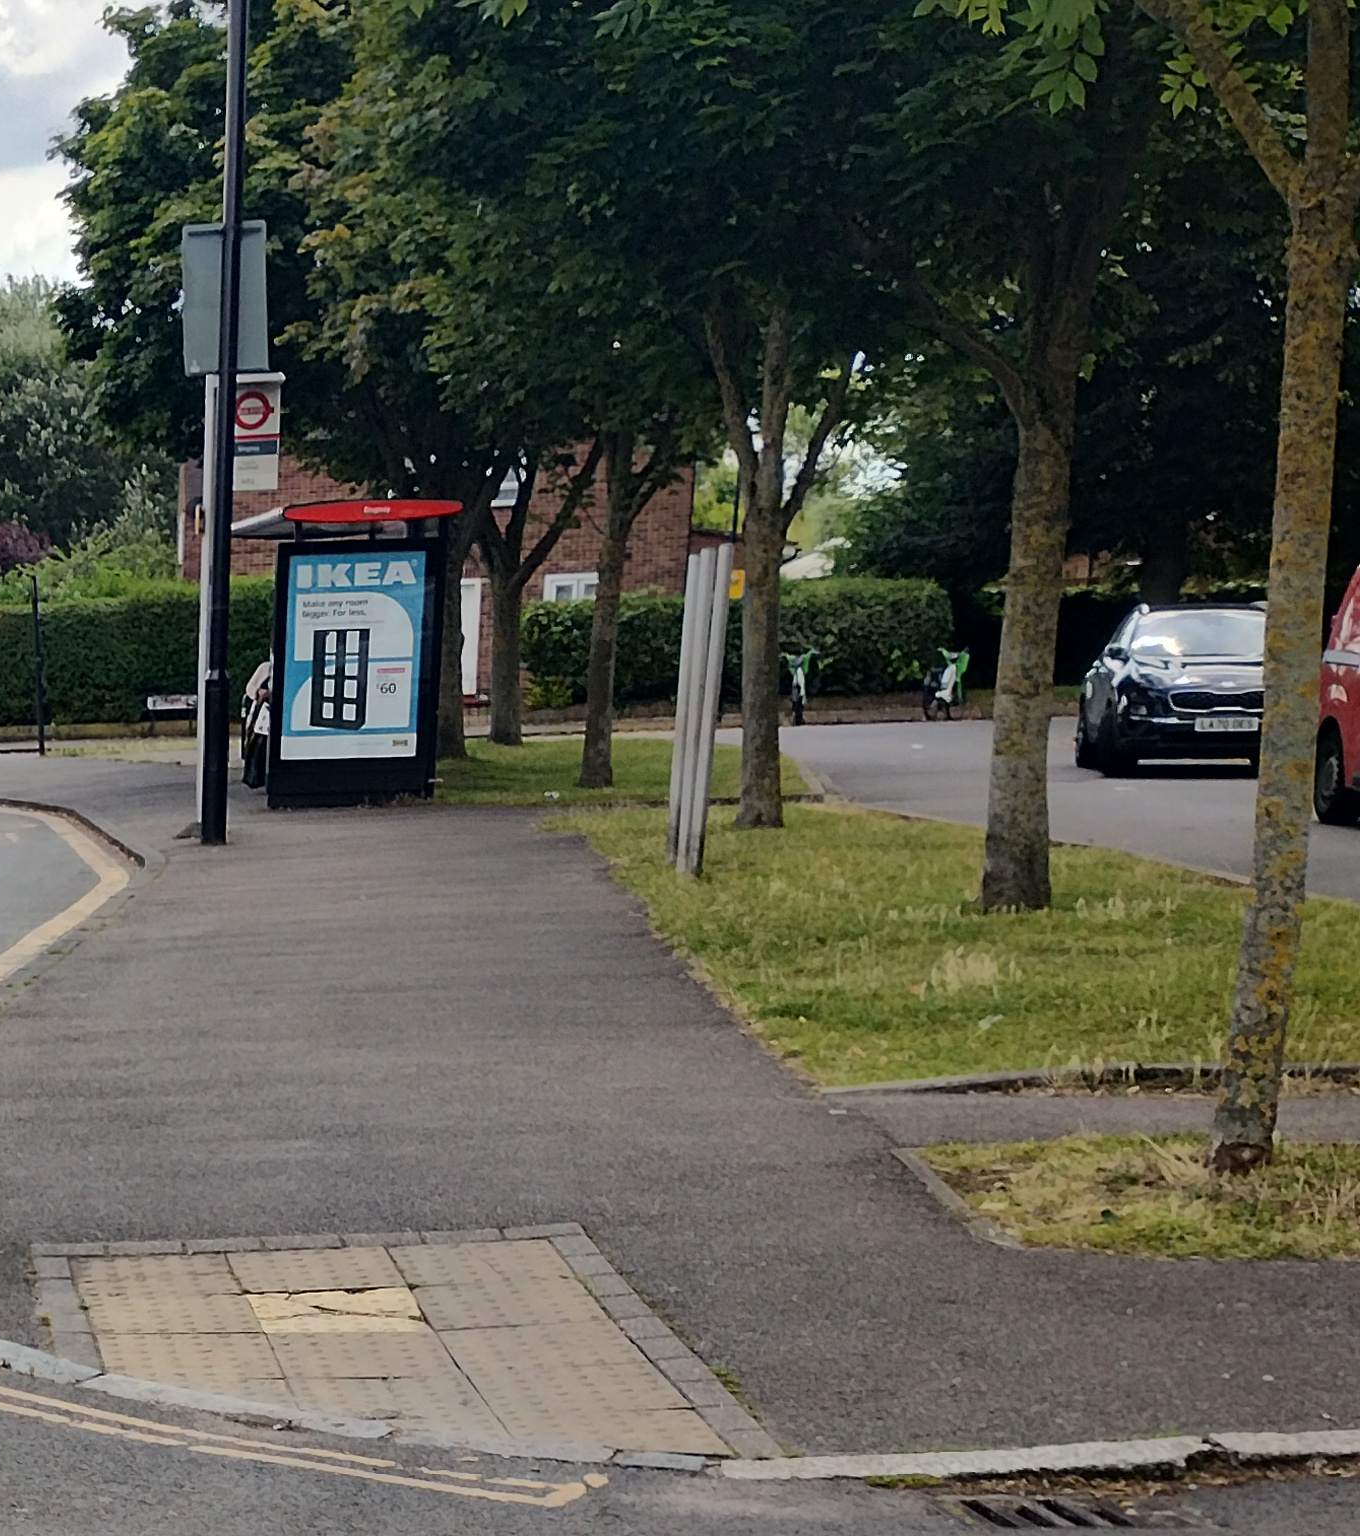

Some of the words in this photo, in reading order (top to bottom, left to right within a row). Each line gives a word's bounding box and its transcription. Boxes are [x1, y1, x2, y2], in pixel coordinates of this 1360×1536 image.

[296, 560, 417, 589] IKEA
[302, 599, 326, 608] Make
[345, 599, 369, 607] room
[333, 608, 346, 618] For
